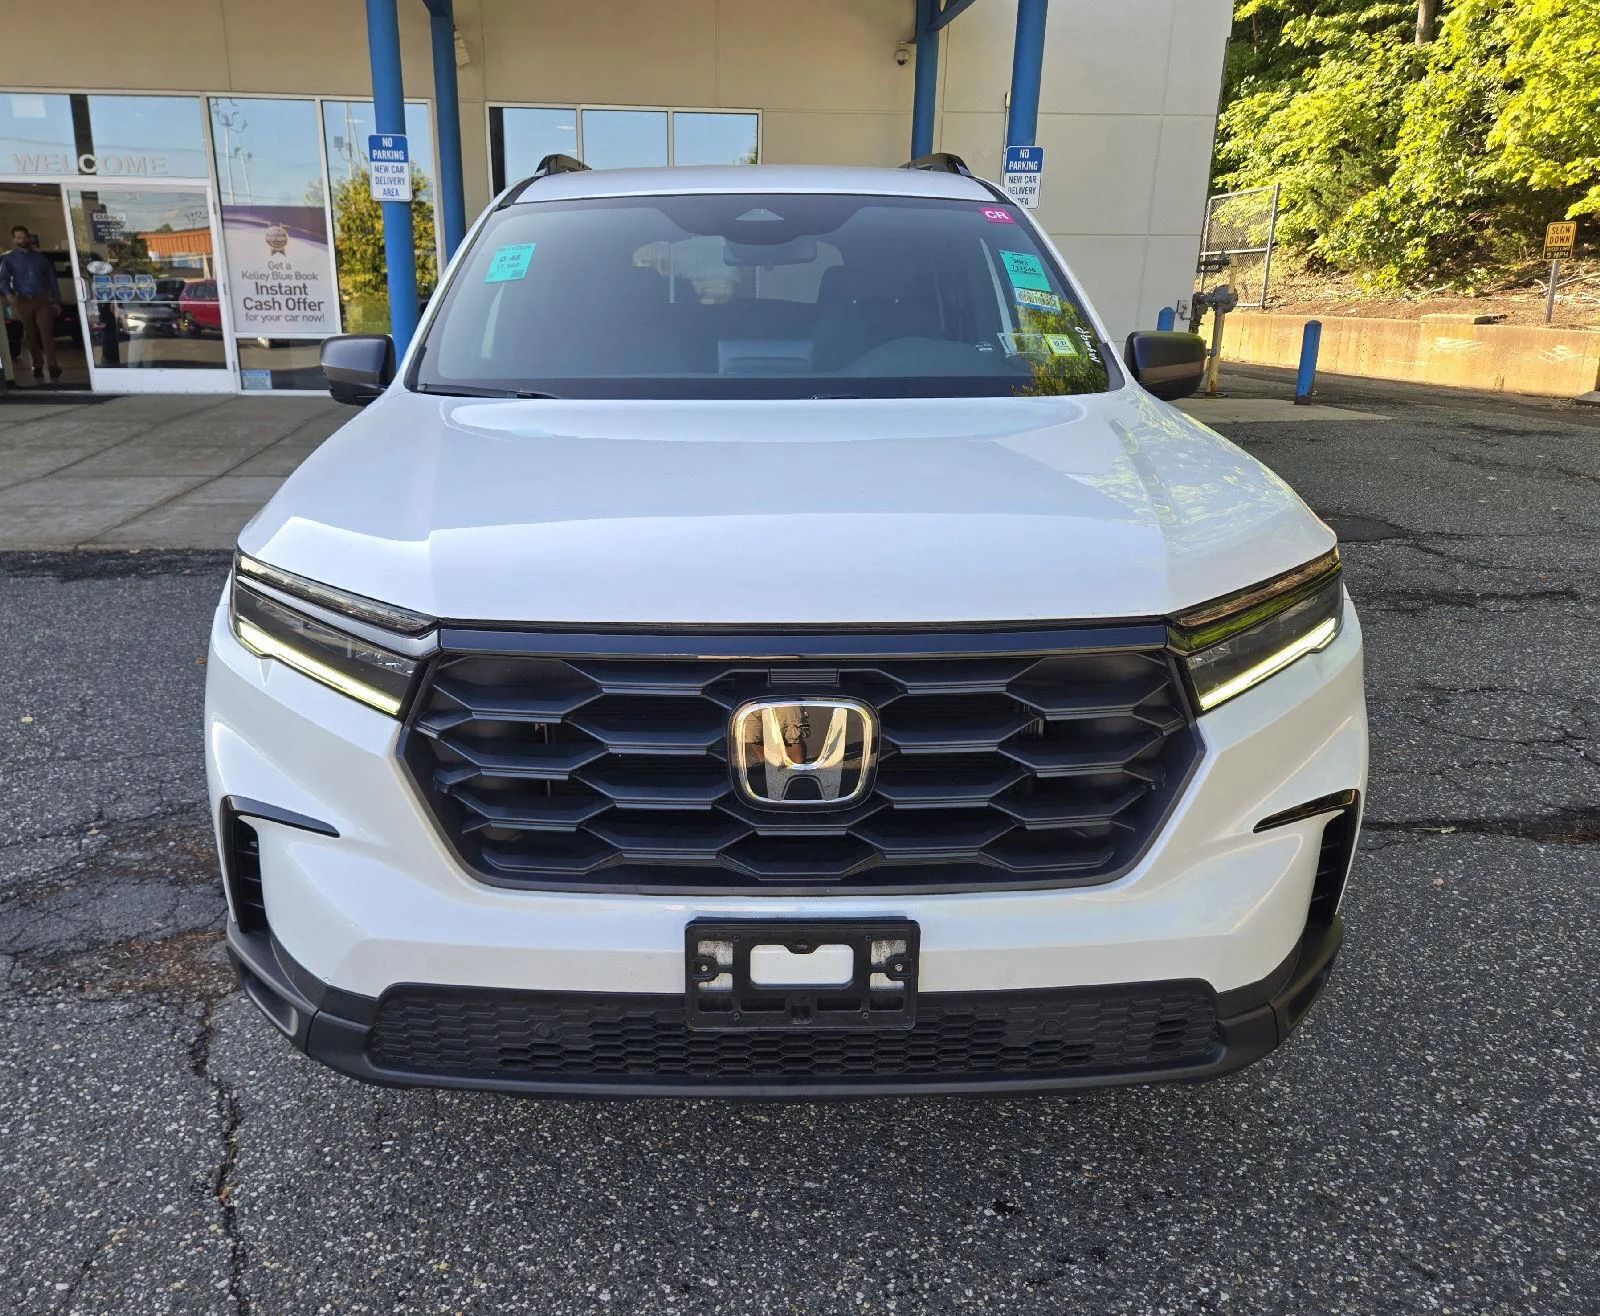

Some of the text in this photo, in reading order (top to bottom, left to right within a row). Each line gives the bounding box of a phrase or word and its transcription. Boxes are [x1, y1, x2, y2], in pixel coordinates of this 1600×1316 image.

[382, 137, 393, 148] NO
[372, 150, 405, 160] PARKING
[1020, 148, 1030, 159] NO
[13, 153, 168, 176] WELCOME
[374, 165, 405, 174] NEW CAR
[1008, 160, 1038, 171] PARKING
[375, 176, 406, 185] DELIVERY
[1008, 175, 1037, 184] NEW CAR
[383, 187, 400, 198] AREA
[1007, 186, 1037, 195] DELIVERY
[984, 210, 1010, 220] CR
[1552, 226, 1571, 234] SLOW
[1550, 236, 1570, 244] DOWN
[268, 261, 292, 270] Get a
[241, 271, 318, 282] Kelley Blue Book
[255, 281, 309, 295] Instant
[243, 297, 325, 311] Cash Offer
[245, 313, 325, 323] for your car now!
